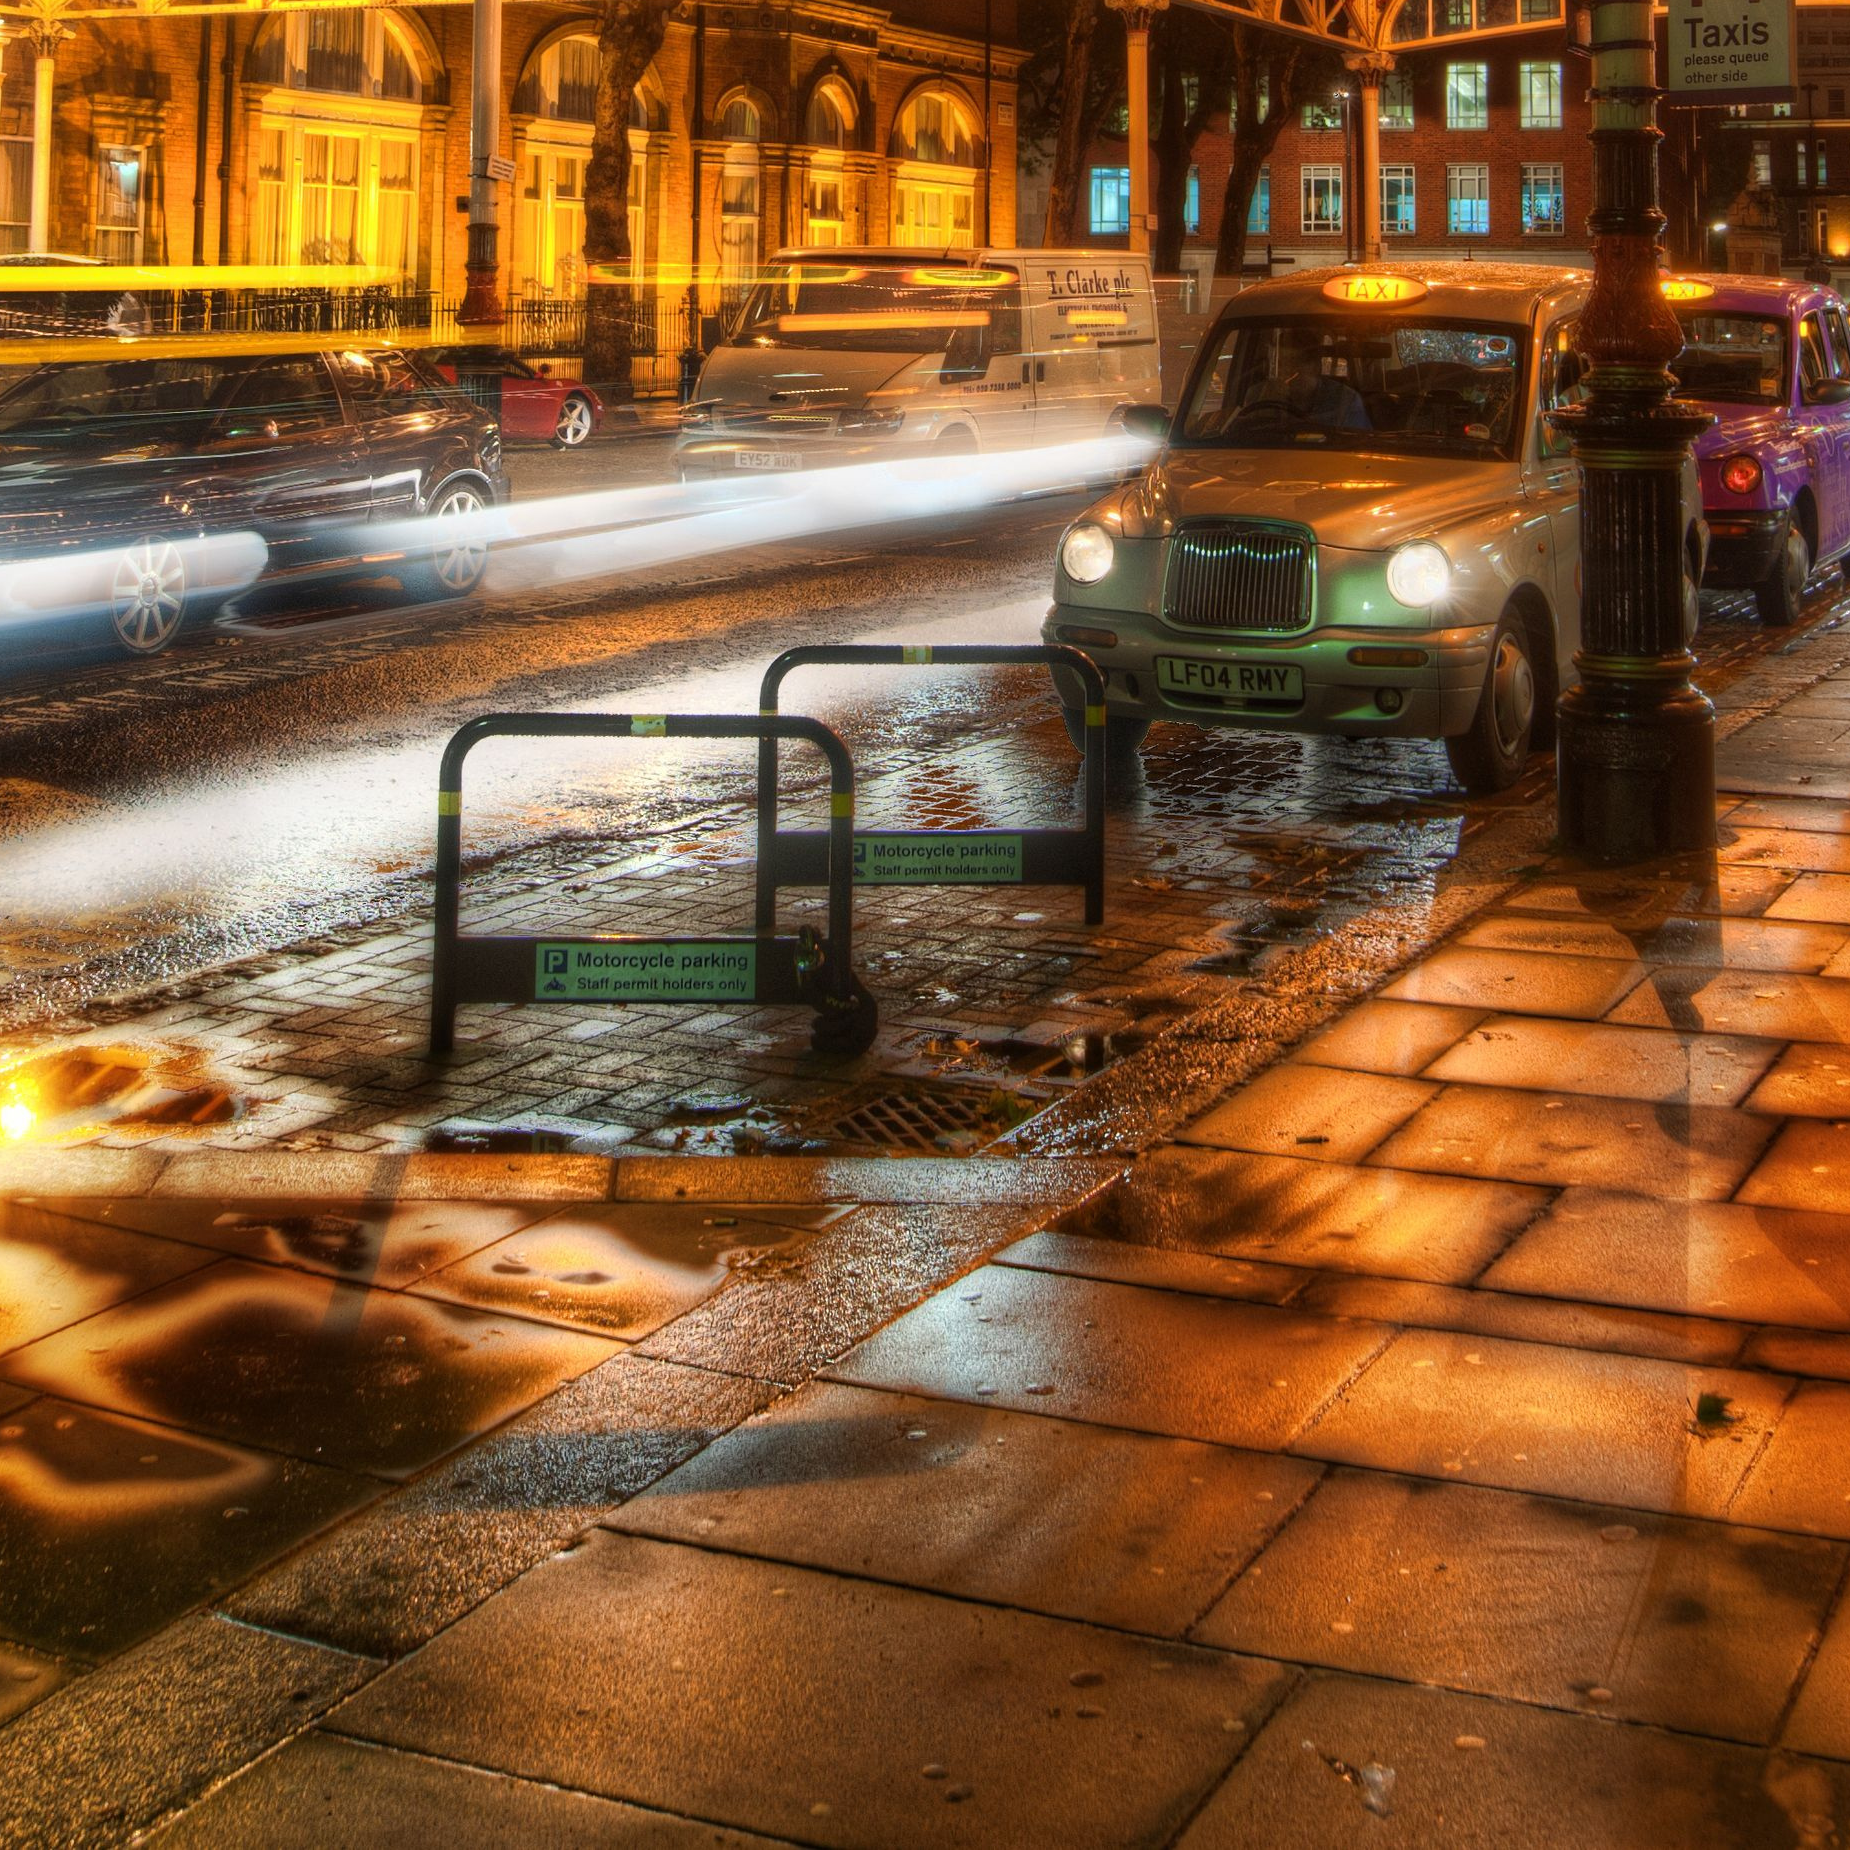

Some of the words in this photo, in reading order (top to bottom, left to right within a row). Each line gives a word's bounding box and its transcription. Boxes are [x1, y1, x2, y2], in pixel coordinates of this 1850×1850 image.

[1683, 14, 1770, 48] Taxis
[1684, 54, 1726, 68] please
[1729, 52, 1770, 66] queue
[1685, 71, 1718, 85] other
[1721, 69, 1749, 83] side
[1066, 269, 1110, 295] Clarke
[1113, 269, 1131, 300] plc
[1342, 281, 1400, 299] TAXI
[1168, 660, 1232, 690] LF04
[1239, 667, 1289, 692] RMY
[874, 843, 955, 860] Motorcycle
[960, 843, 1017, 860] parking
[874, 864, 901, 876] Staff
[905, 864, 942, 877] permit
[944, 863, 989, 876] holders
[991, 863, 1016, 876] only
[576, 951, 675, 971] Motorcycle
[681, 951, 749, 971] parking
[576, 977, 609, 990] Staff
[613, 977, 659, 992] permit
[662, 977, 715, 990] holders
[718, 977, 748, 993] only
